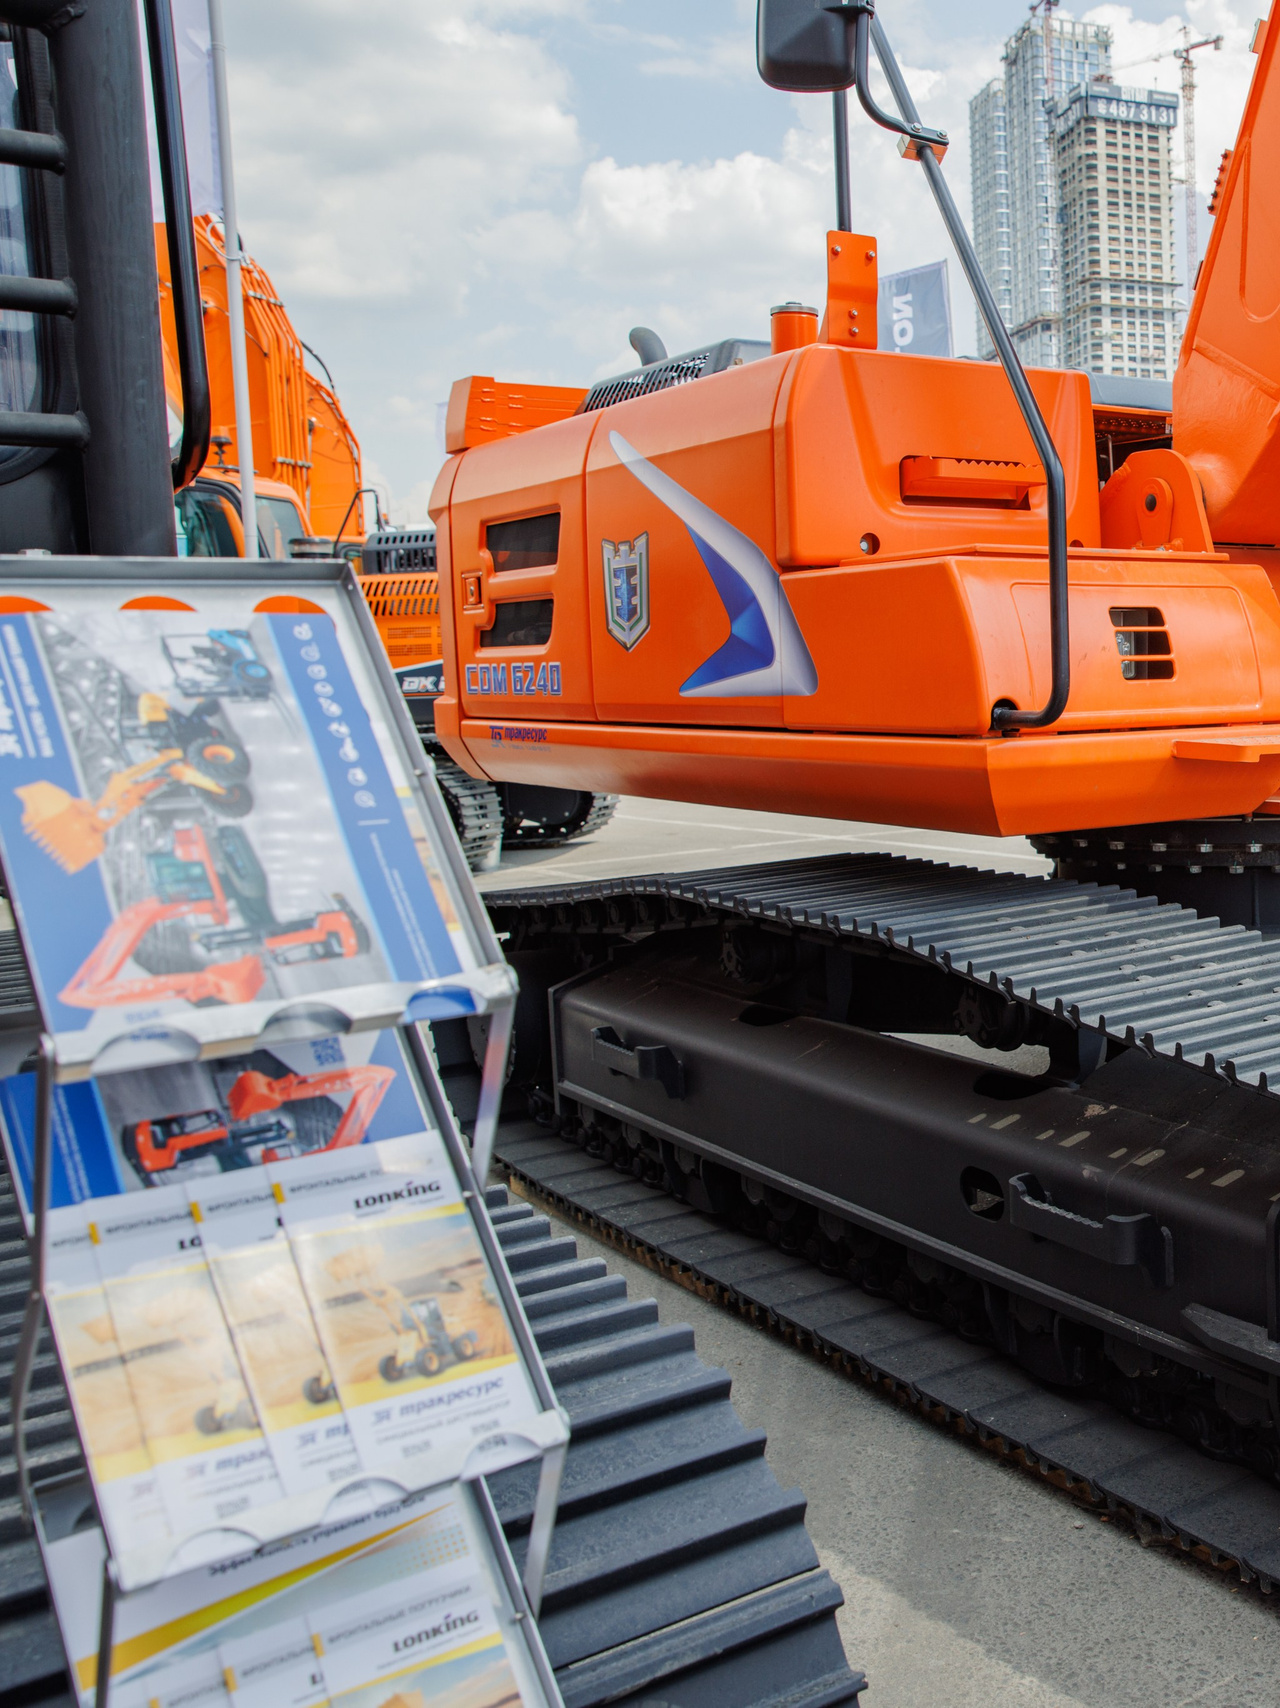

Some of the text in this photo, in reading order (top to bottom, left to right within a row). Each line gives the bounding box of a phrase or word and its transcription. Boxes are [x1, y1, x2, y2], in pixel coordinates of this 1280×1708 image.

[1109, 99, 1136, 119] 487
[465, 663, 508, 695] CDM
[511, 661, 563, 696] 6240
[505, 727, 549, 743] тракресурс
[354, 1179, 442, 1210] LONKING
[392, 1612, 480, 1652] LONKING
